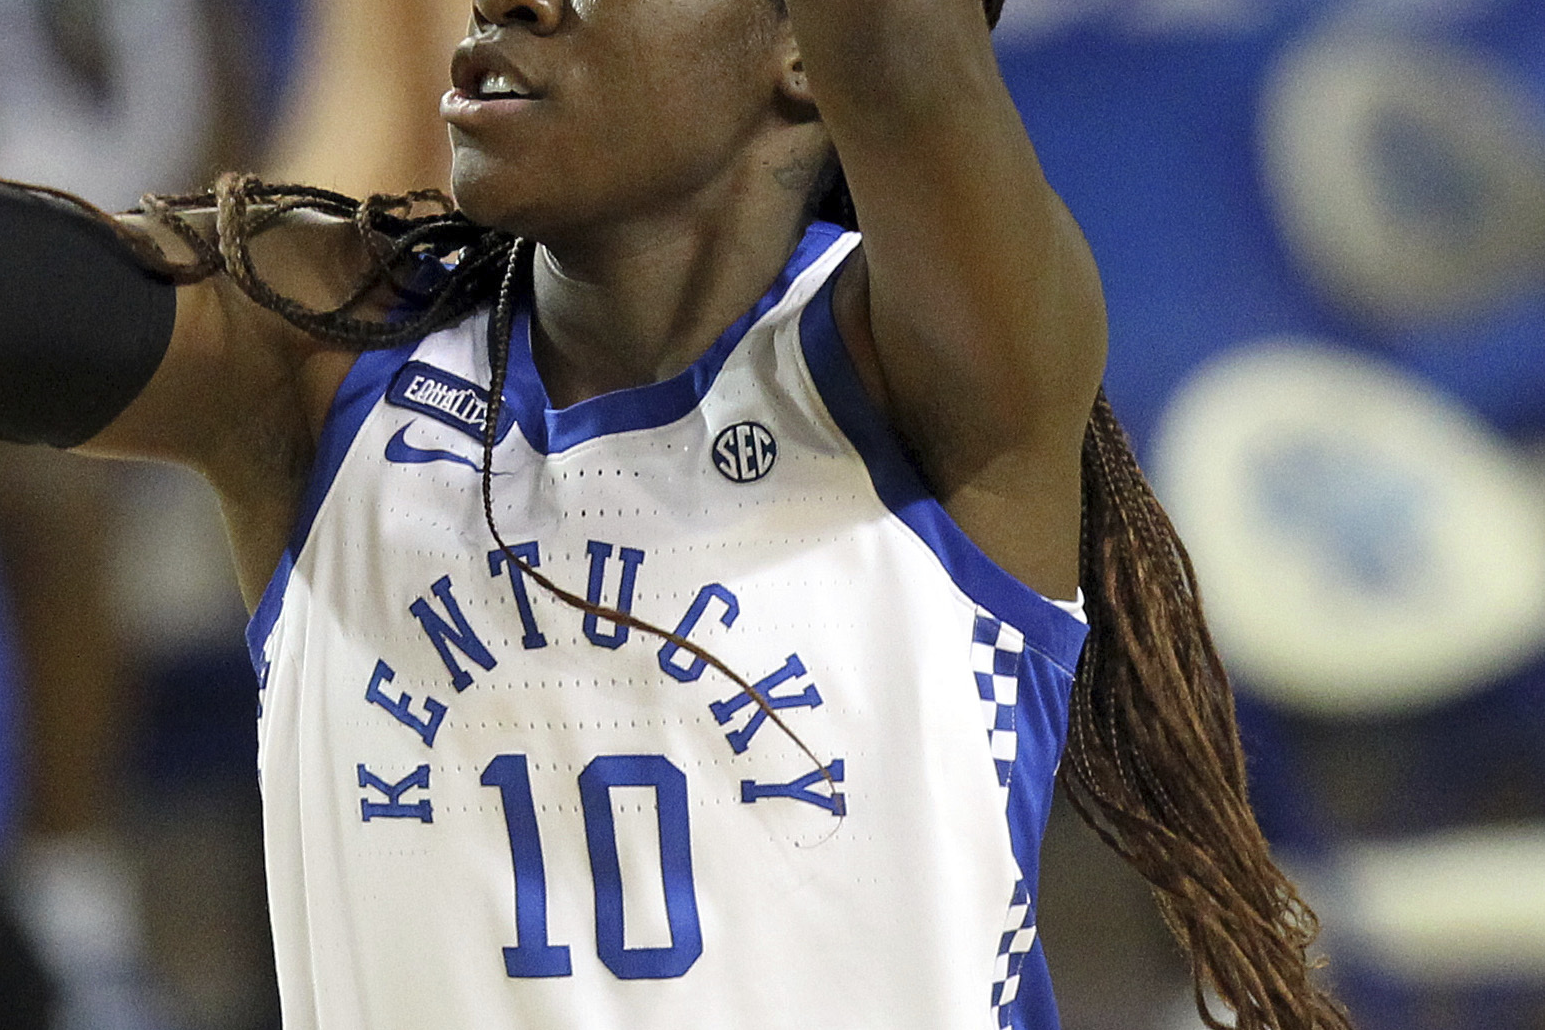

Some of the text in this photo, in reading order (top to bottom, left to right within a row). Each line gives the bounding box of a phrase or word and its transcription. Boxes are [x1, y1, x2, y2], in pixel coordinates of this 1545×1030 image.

[716, 424, 774, 480] SEC
[357, 539, 846, 824] KENTUCKY
[480, 753, 703, 980] 10
